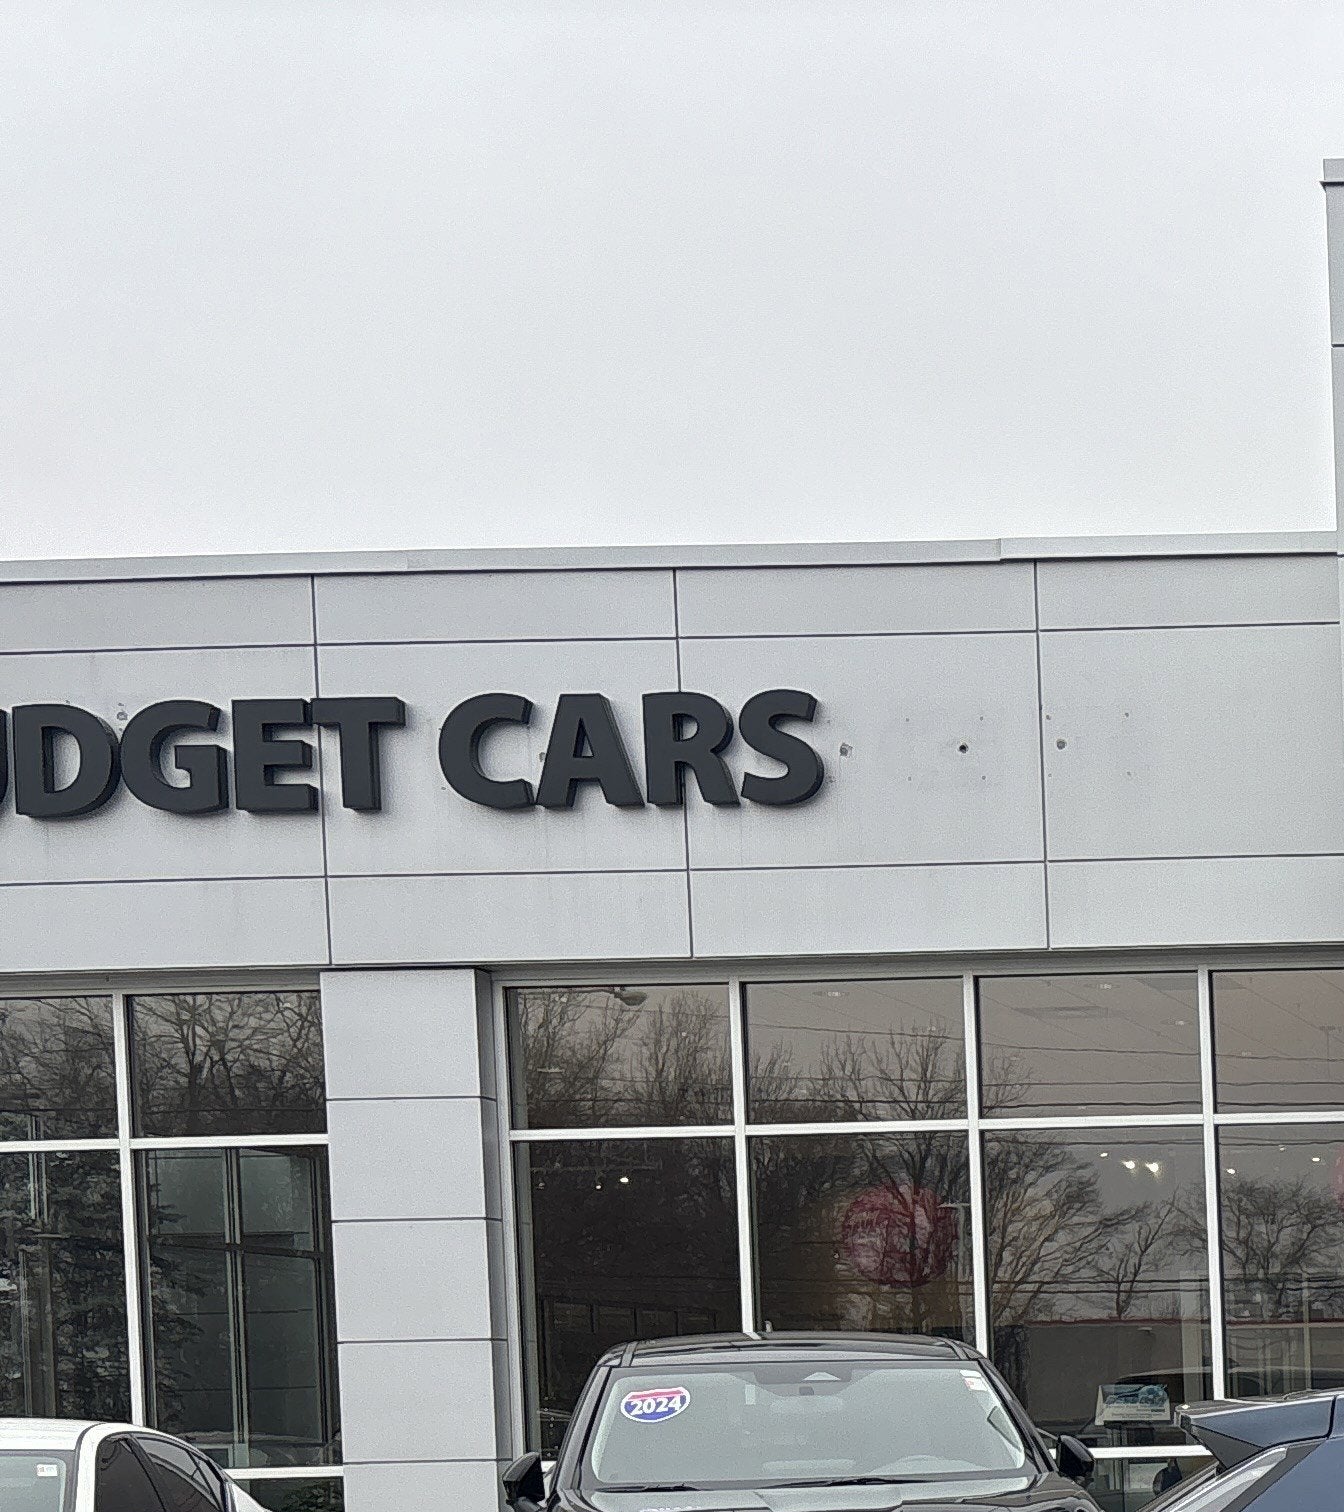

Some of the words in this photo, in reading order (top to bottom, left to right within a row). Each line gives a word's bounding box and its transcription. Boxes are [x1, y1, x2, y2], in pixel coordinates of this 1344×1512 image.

[0, 696, 407, 819] DGET
[439, 688, 825, 811] CARS
[629, 1394, 682, 1415] 2024
